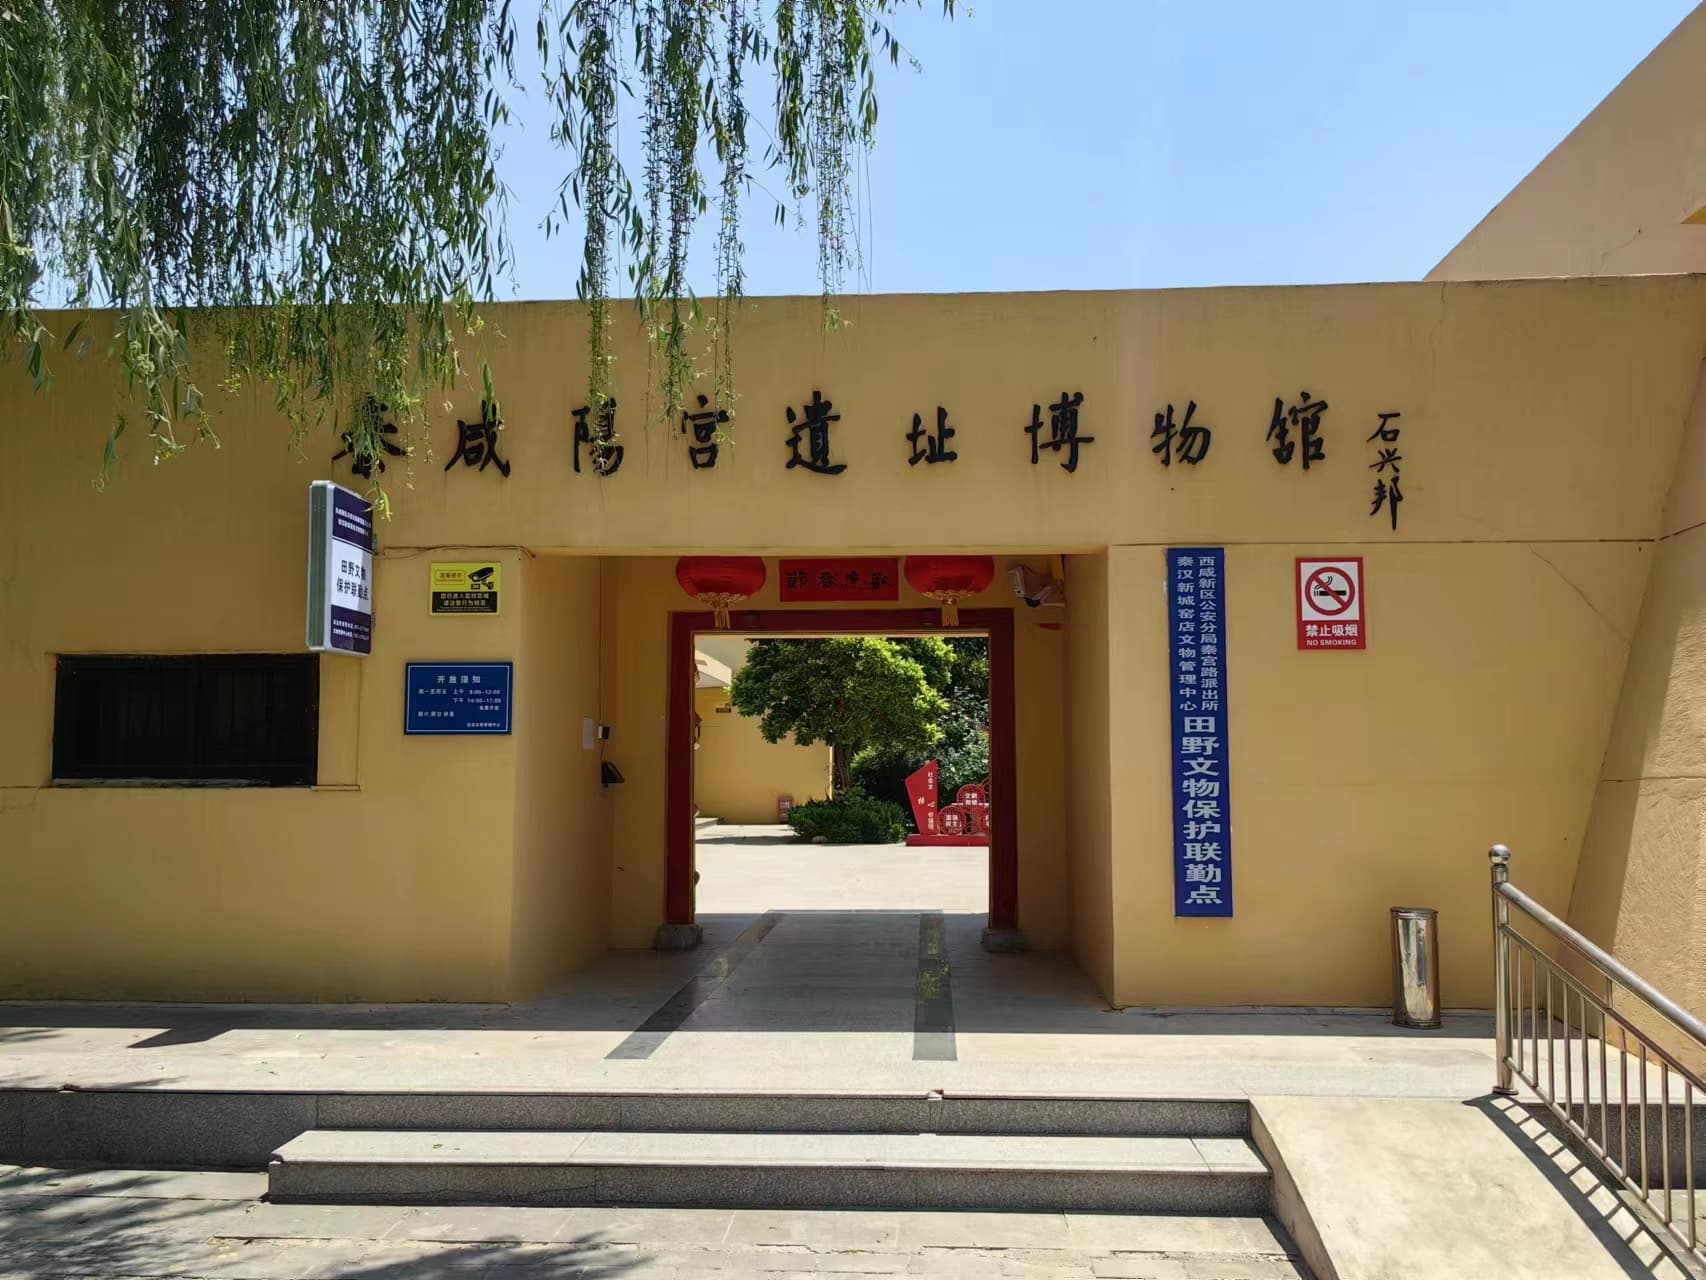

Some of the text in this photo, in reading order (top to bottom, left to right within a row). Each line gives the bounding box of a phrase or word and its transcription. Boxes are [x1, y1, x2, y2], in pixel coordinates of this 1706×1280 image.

[1366, 412, 1403, 531] 石兴邦
[337, 577, 369, 600] 保护联勤点
[341, 559, 366, 580] 田野文物
[1177, 556, 1198, 711] 秦汉新城窑店文物管理中心
[1198, 556, 1219, 711] 西咸新区公安分局秦宫路派出所
[1305, 624, 1358, 637] 禁止吸烟
[1180, 716, 1222, 904] 田野文物保护联勤点
